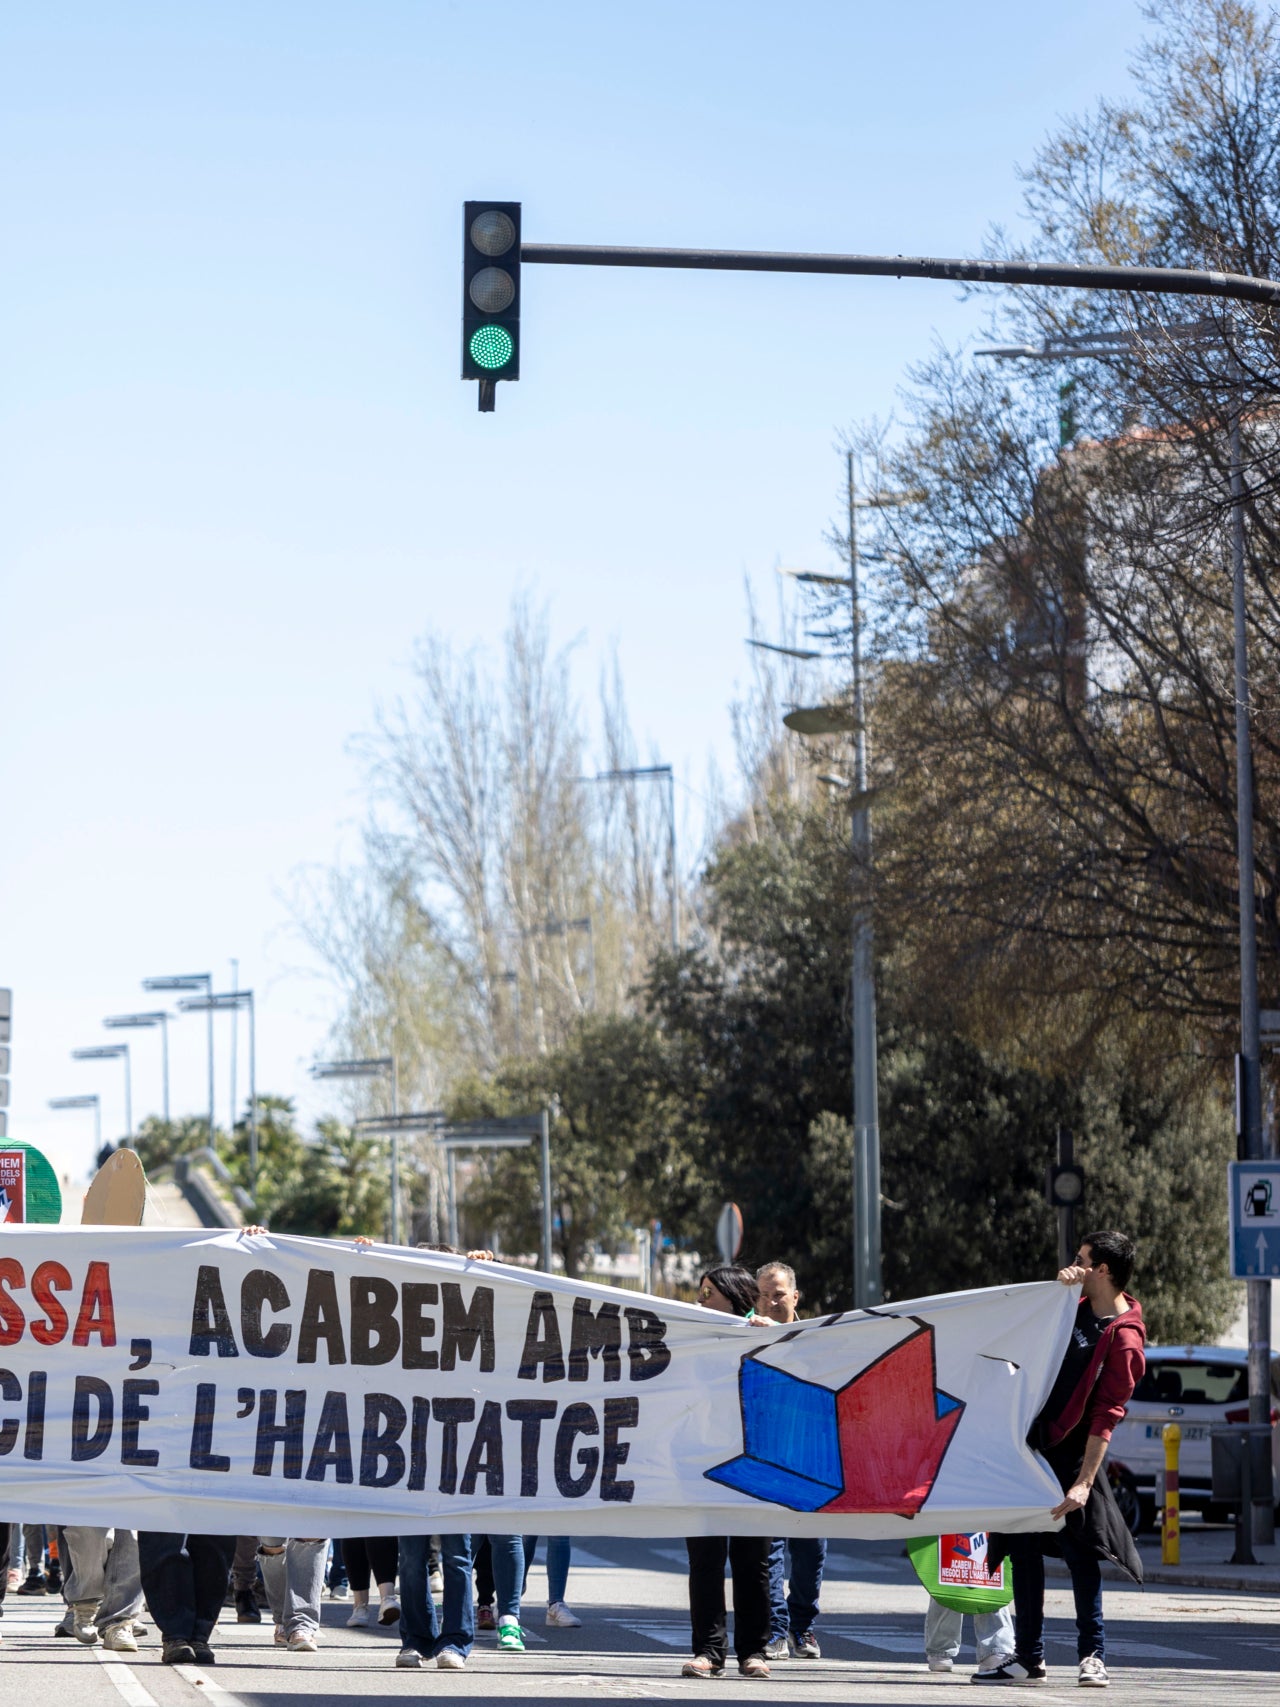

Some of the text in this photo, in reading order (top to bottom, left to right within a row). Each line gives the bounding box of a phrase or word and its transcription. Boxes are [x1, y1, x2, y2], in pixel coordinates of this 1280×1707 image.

[0, 1169, 20, 1178] DELS
[188, 1265, 495, 1372] ACABEM
[517, 1291, 672, 1383] AMB
[71, 1375, 160, 1467] DE
[189, 1382, 640, 1502] L'HABITATGE
